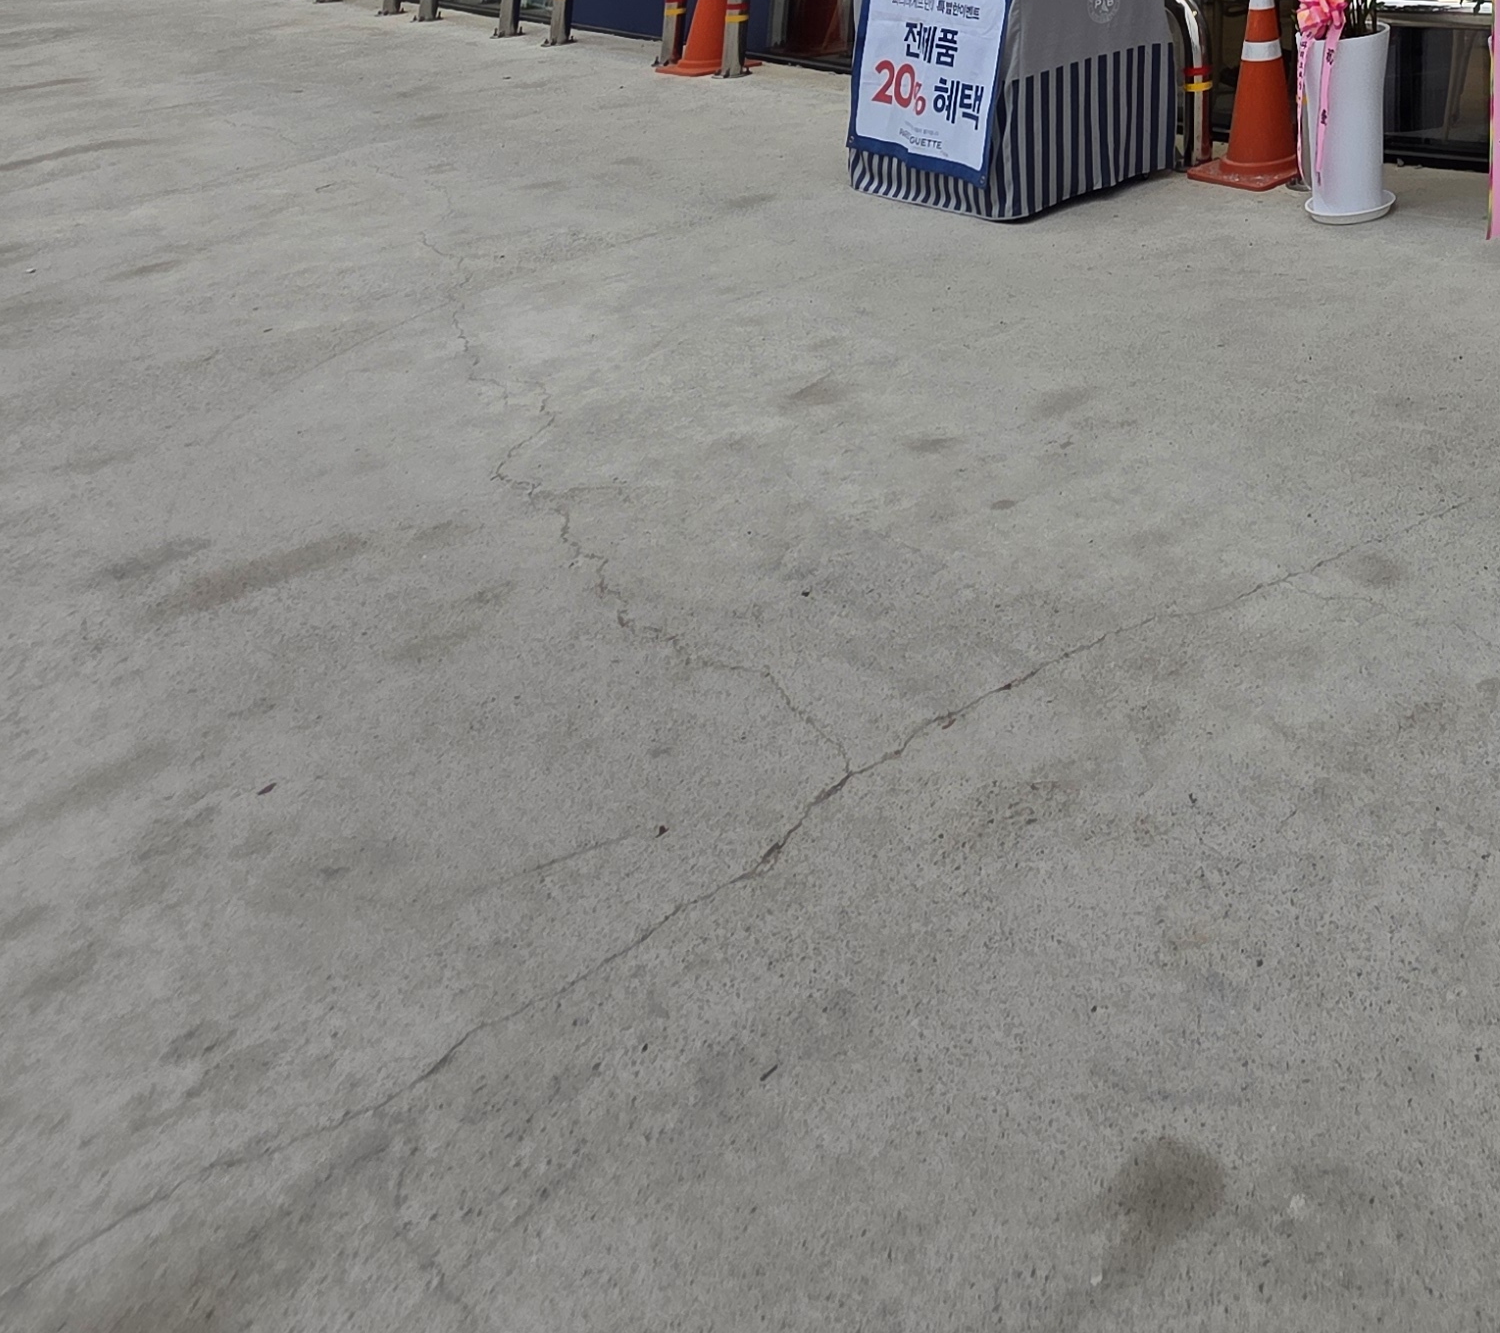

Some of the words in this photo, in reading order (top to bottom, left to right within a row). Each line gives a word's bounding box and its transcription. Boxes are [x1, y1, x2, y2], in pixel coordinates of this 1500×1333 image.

[903, 22, 959, 68] 전제품
[872, 60, 926, 116] 20%
[933, 77, 984, 131] 혜택
